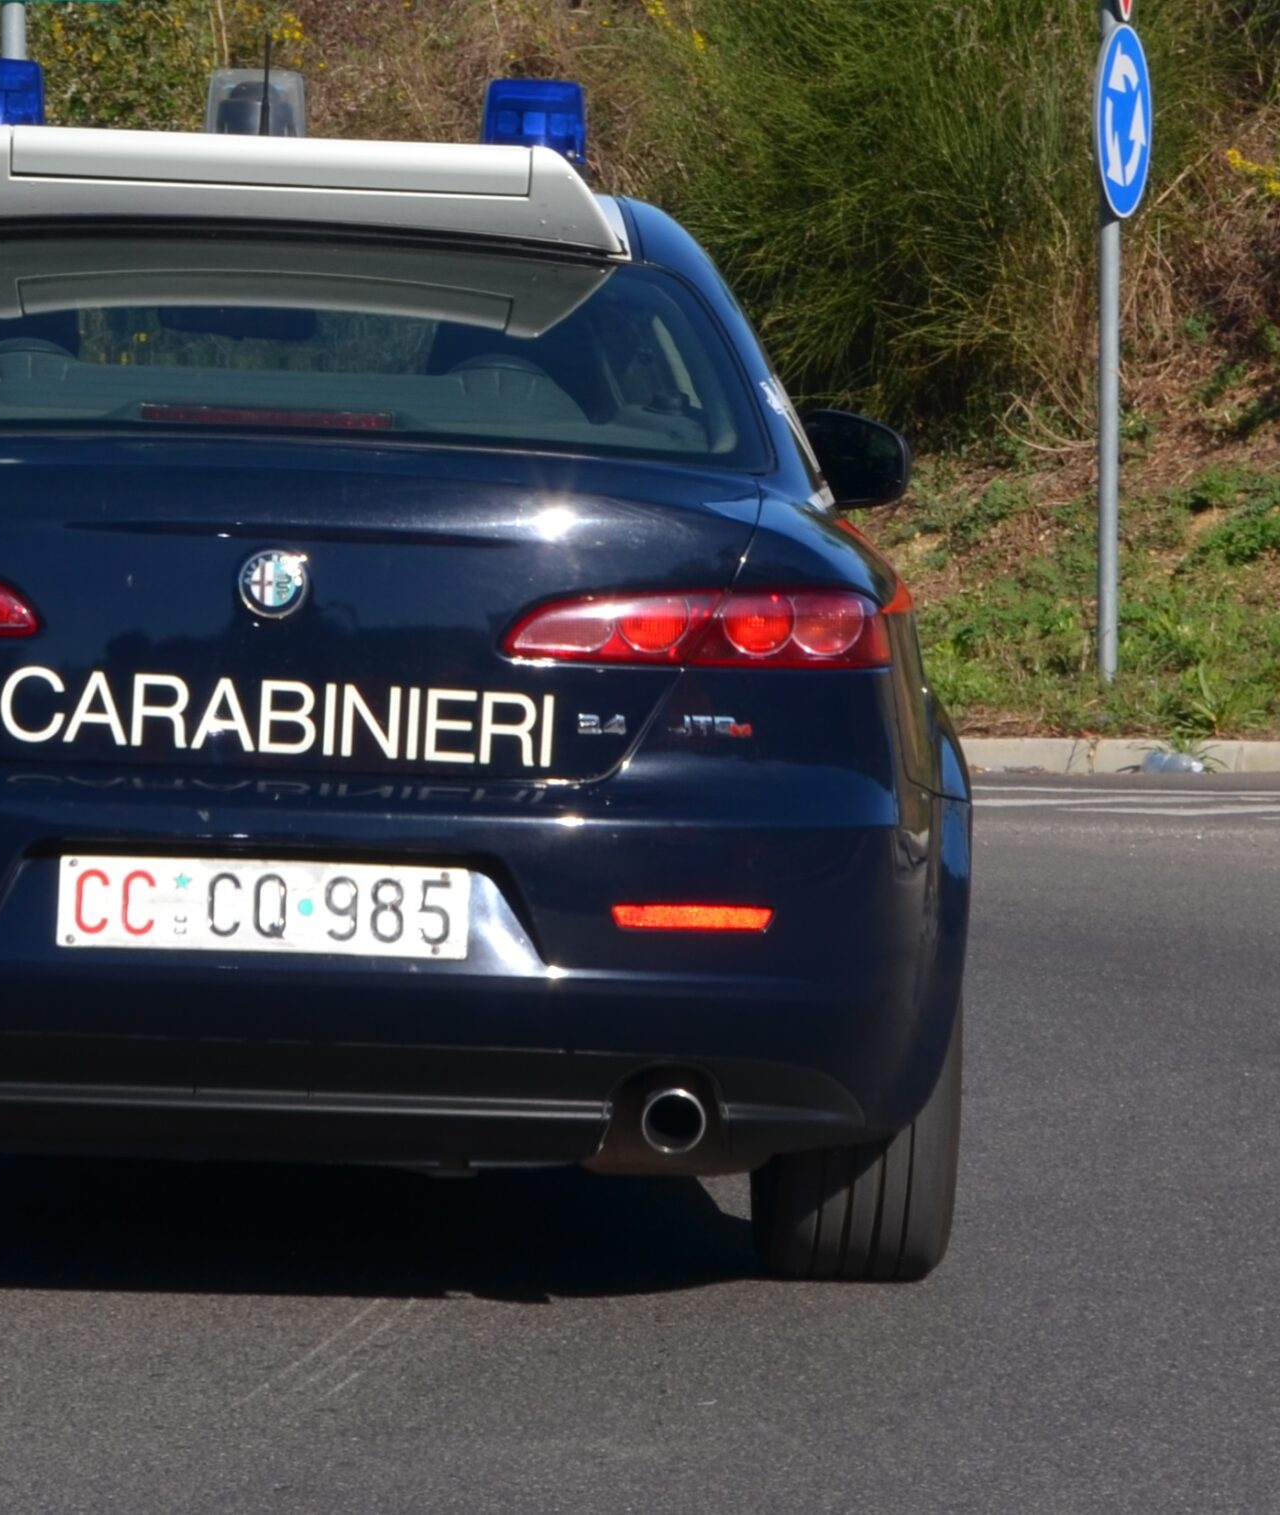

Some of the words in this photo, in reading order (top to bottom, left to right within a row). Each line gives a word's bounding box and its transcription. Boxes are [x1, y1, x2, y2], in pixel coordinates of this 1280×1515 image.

[0, 666, 555, 768] CARABINIERI
[74, 869, 156, 935] CC
[207, 873, 287, 939] CQ
[324, 876, 452, 945] 985
